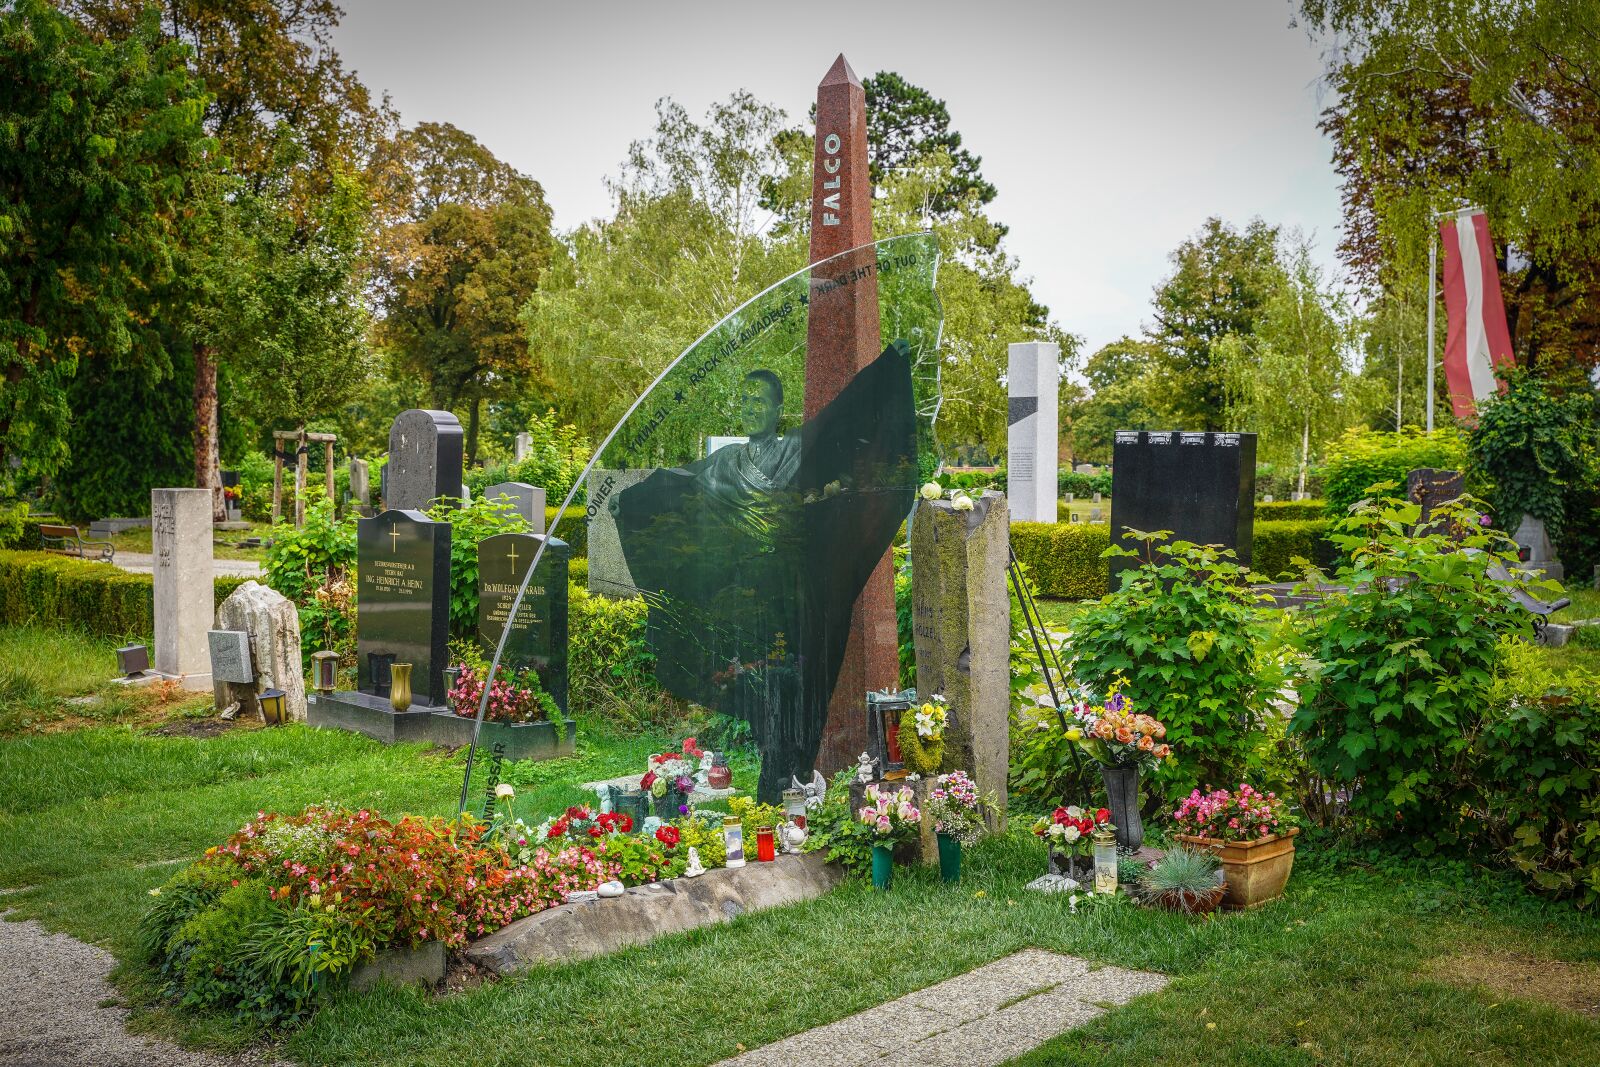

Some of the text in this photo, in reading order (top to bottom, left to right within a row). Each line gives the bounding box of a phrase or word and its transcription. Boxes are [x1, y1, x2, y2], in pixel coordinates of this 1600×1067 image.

[823, 133, 841, 225] FALCO
[689, 302, 793, 387] ROCK ME AMADEUS
[376, 575, 400, 586] HEINRICH
